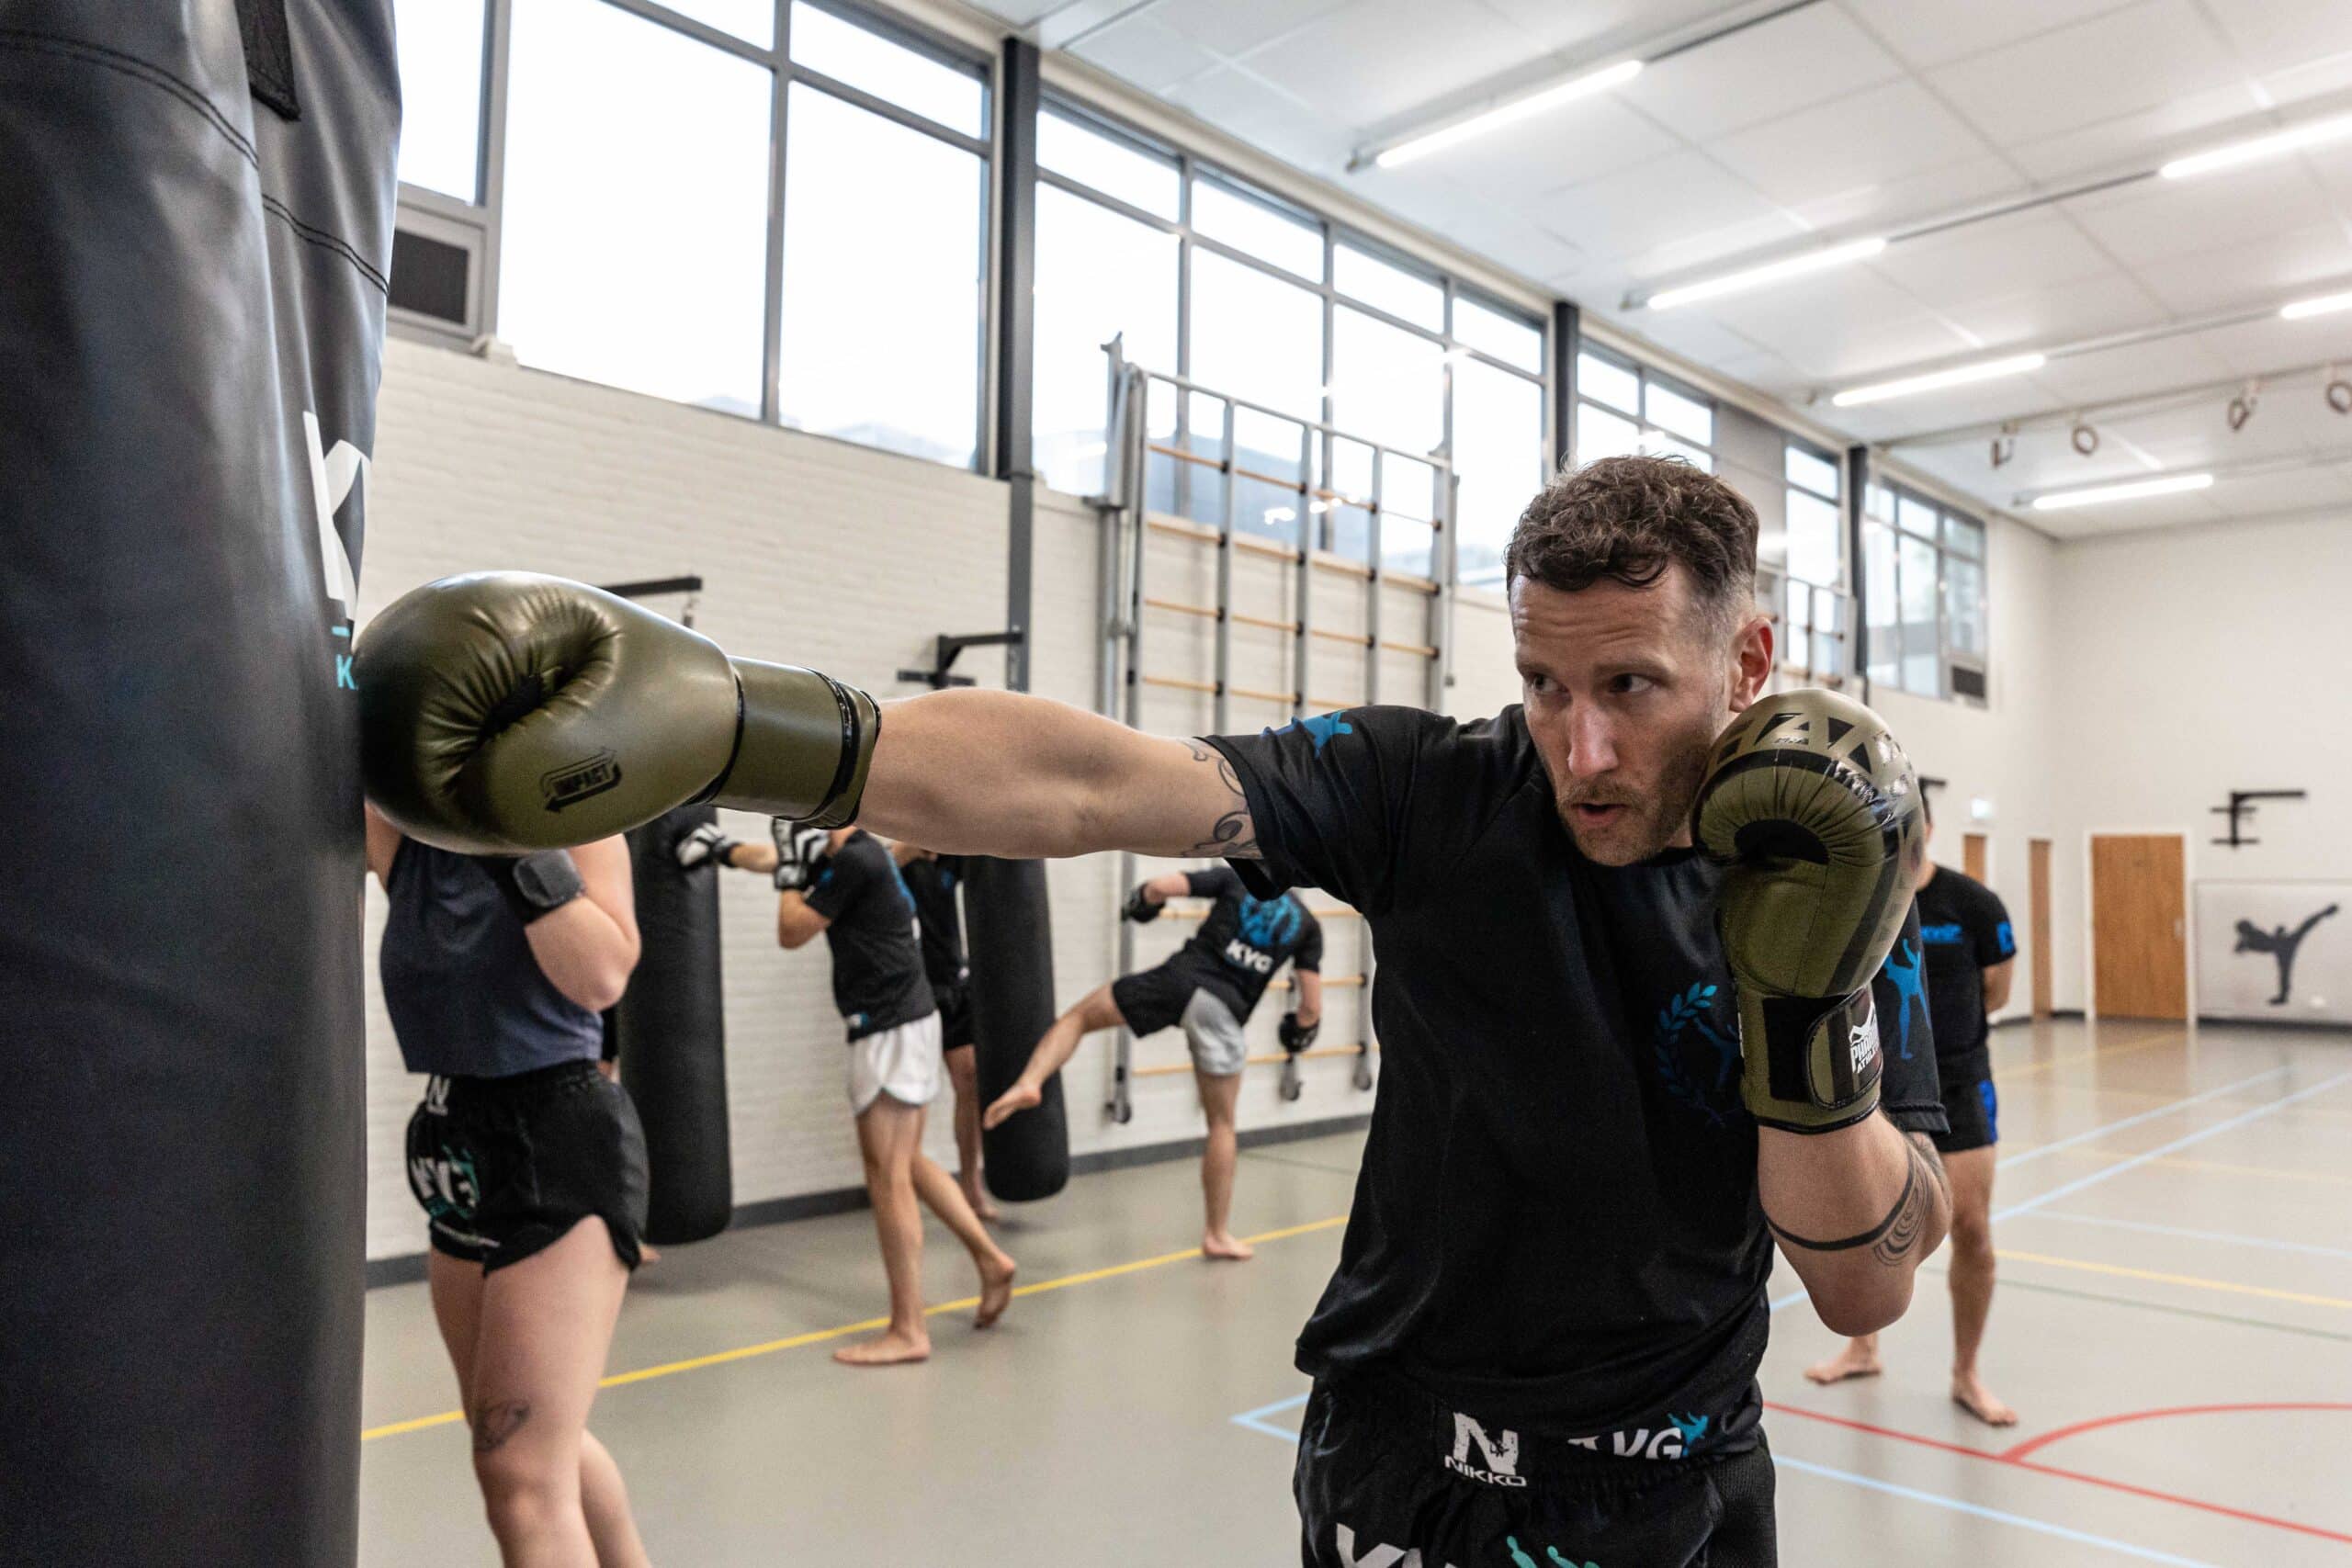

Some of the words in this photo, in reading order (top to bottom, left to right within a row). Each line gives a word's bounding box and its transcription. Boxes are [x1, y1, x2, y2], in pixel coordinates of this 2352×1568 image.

[302, 410, 371, 621] K
[335, 654, 358, 691] K
[1444, 1454, 1527, 1486] NIKKO
